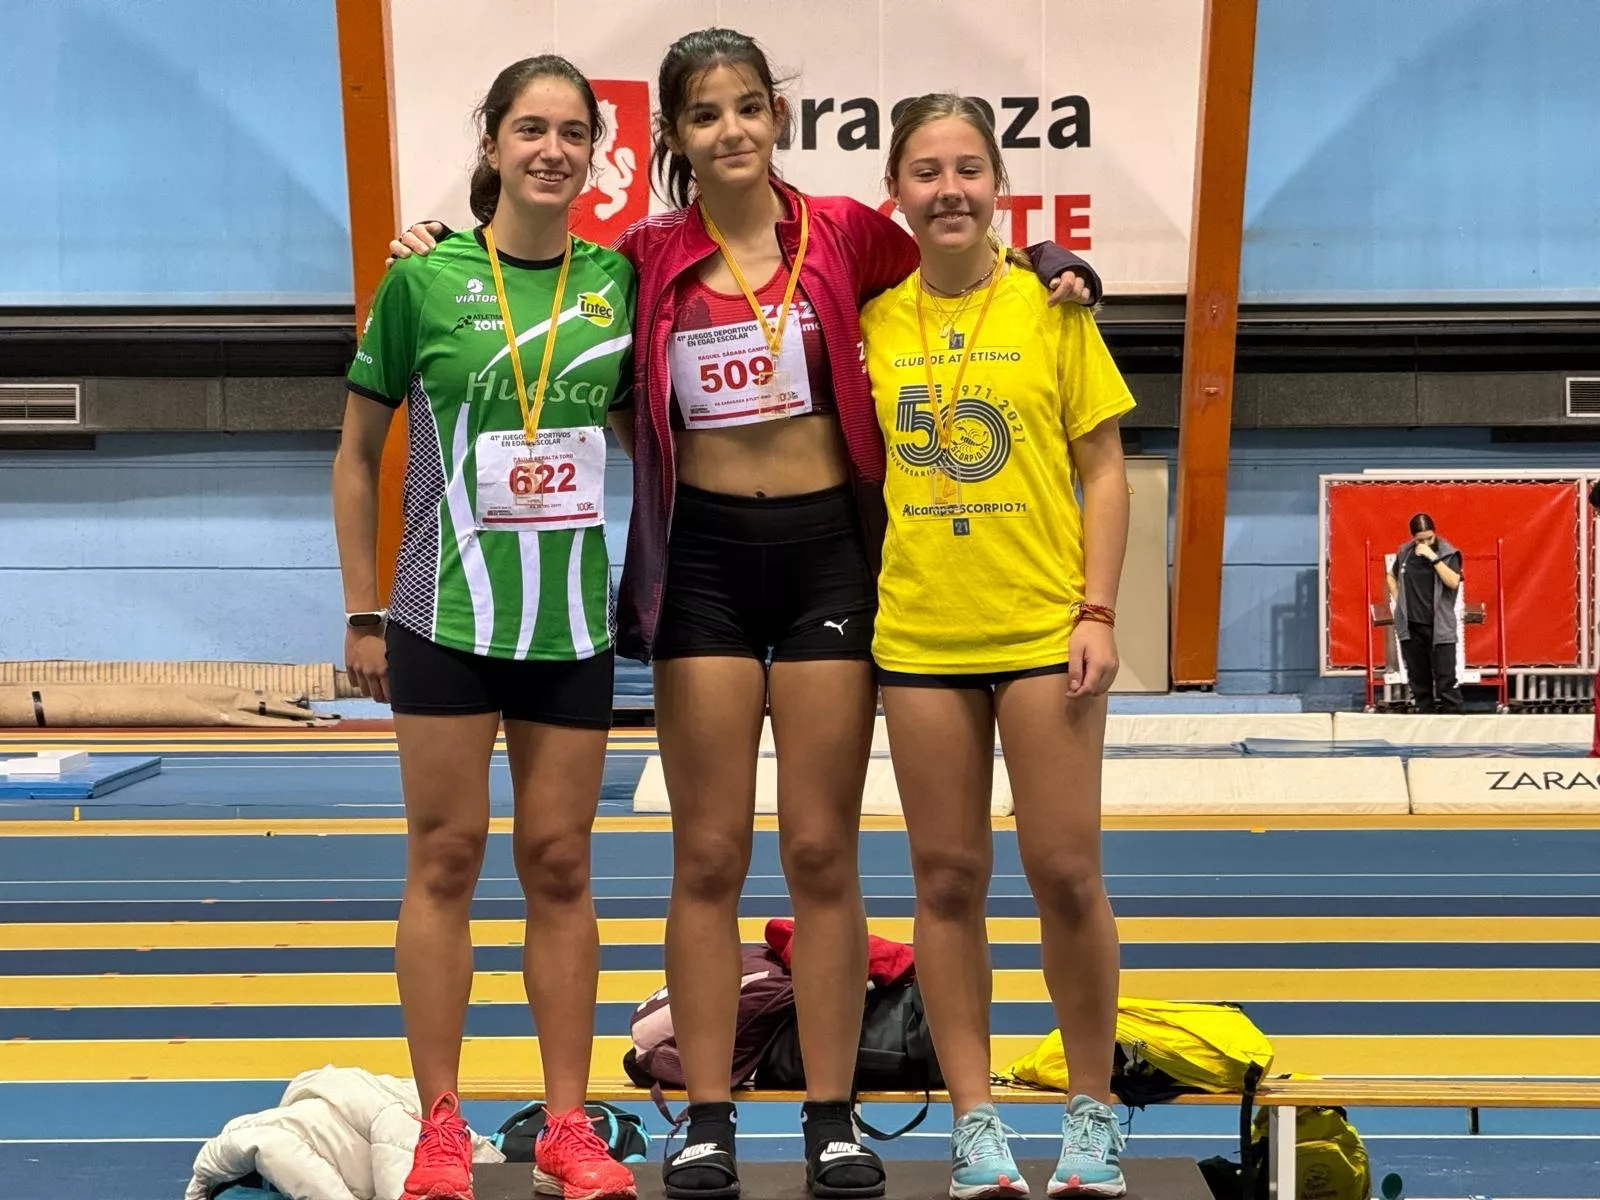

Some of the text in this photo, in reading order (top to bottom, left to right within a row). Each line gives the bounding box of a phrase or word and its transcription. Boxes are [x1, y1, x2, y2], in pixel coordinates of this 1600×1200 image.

[455, 294, 498, 304] VIATOR
[687, 331, 713, 341] JUEGOS
[714, 324, 758, 337] DEPORTIVOS
[697, 338, 716, 346] EDAD
[717, 332, 749, 343] ESCOLAR
[894, 351, 1021, 368] CLUB DE ATETISMO
[700, 356, 774, 394] 509
[533, 431, 572, 440] EPORTIVOS
[509, 463, 577, 496] 622
[1485, 771, 1600, 790] ZARA
[681, 1142, 719, 1159] NIKE
[825, 1141, 861, 1154] NIKE
